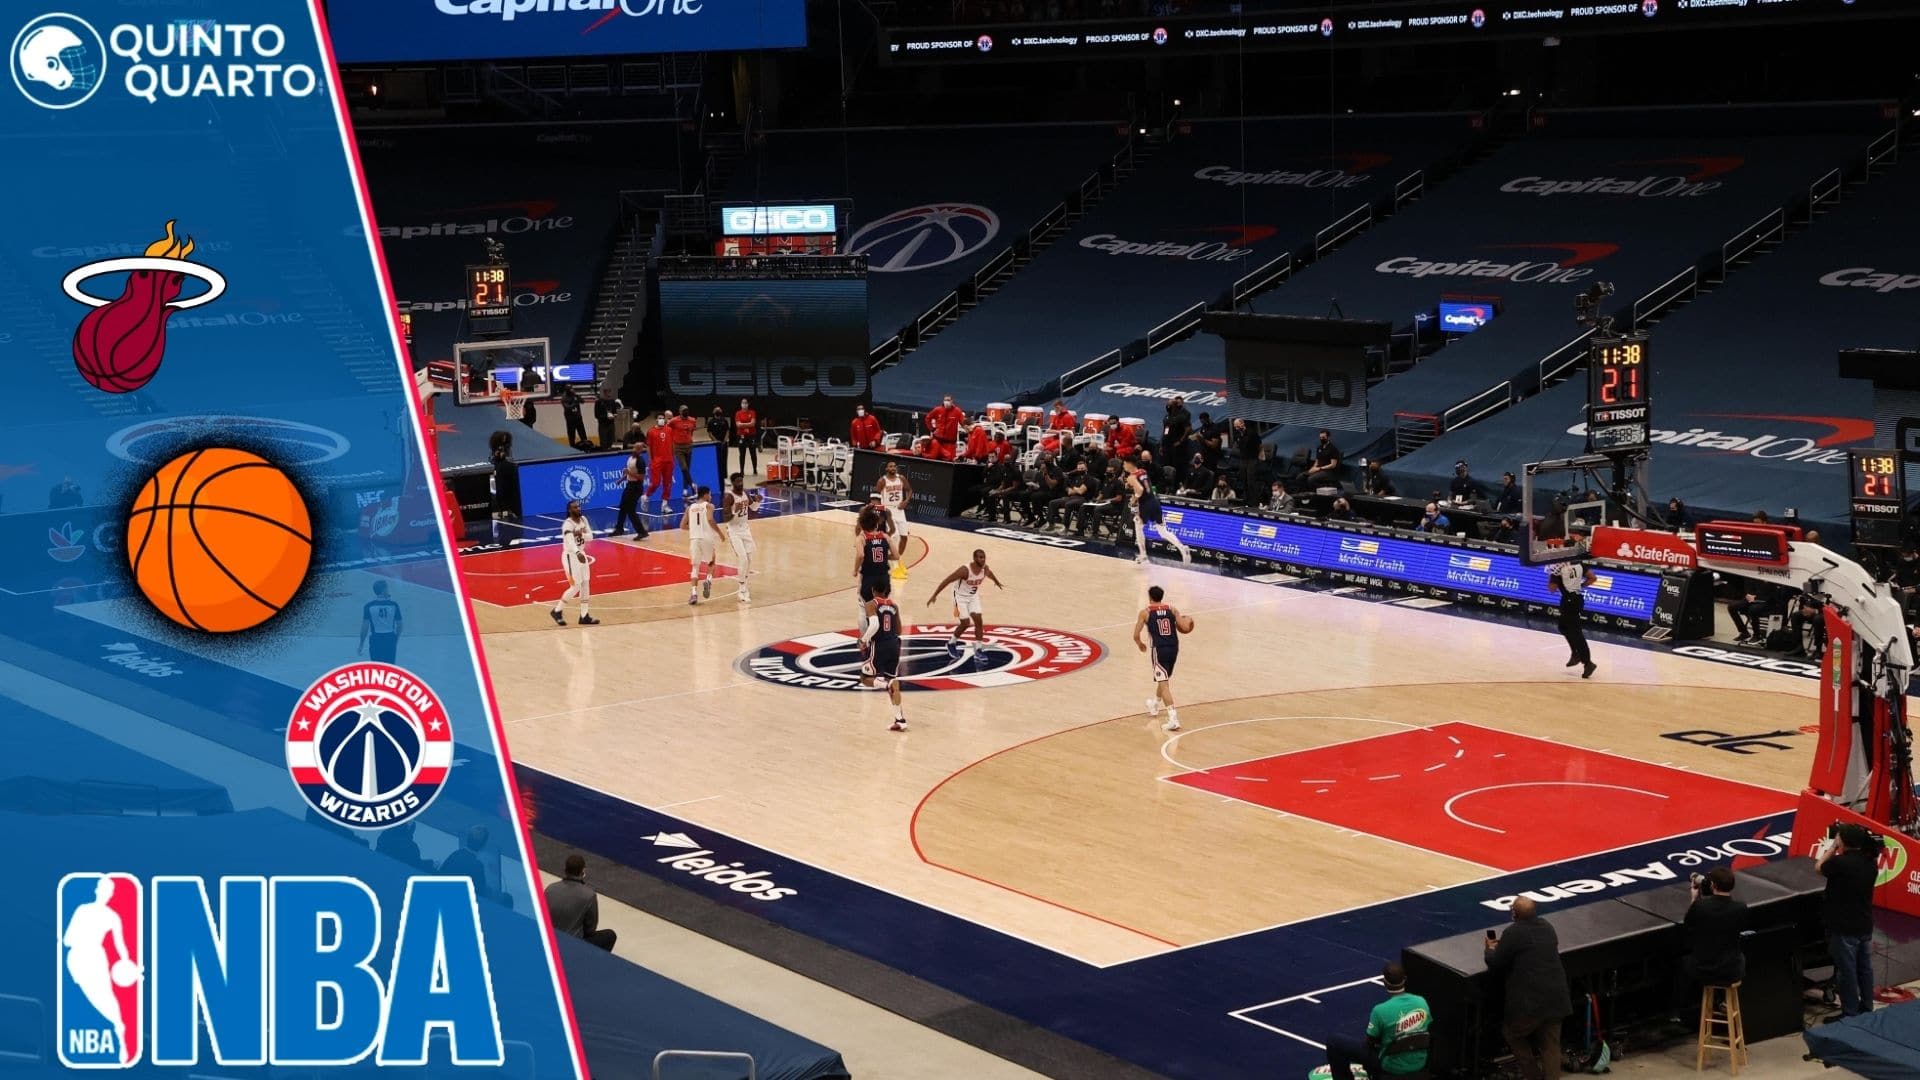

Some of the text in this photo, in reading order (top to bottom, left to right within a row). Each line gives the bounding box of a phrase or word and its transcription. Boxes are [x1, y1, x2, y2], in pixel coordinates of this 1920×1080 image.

[1570, 8, 1594, 16] PROUD
[1596, 5, 1627, 14] SPONSOR
[1628, 4, 1638, 12] OF
[1408, 18, 1429, 26] PROUD
[1430, 16, 1458, 25] SPONSOR
[1459, 15, 1468, 24] OF
[1254, 26, 1277, 34] PROUD
[1278, 25, 1308, 34] SPONSOR
[1309, 24, 1318, 32] OF
[931, 41, 962, 50] SPONSOR
[964, 40, 974, 48] OF
[1086, 35, 1110, 44] PROUD
[1111, 34, 1140, 42] SPONSOR
[1141, 33, 1150, 41] OF
[730, 209, 828, 231] GEICO
[475, 269, 504, 283] 11:38
[476, 284, 502, 305] 21
[481, 308, 510, 316] TISSOT
[1601, 344, 1641, 366] 11:38
[667, 358, 868, 397] GEICO
[1602, 368, 1638, 403] 21
[1239, 367, 1353, 408] GEICO
[1610, 408, 1646, 421] TISSOT
[1861, 457, 1894, 475] 11:38
[1864, 474, 1889, 496] 21
[889, 492, 900, 502] 25
[1867, 504, 1900, 514] TISSOT
[696, 512, 700, 526] 1
[1240, 536, 1271, 552] MedStar
[1272, 540, 1300, 556] Health
[872, 547, 884, 562] 15
[1338, 553, 1405, 573] MedStar Health
[1344, 574, 1384, 588] WE ARE WGL
[1446, 570, 1520, 590] MedStar Health
[1609, 595, 1645, 610] Health
[1157, 618, 1171, 636] 19
[656, 850, 798, 900] leidos
[1396, 1012, 1424, 1033] LIBMAN
